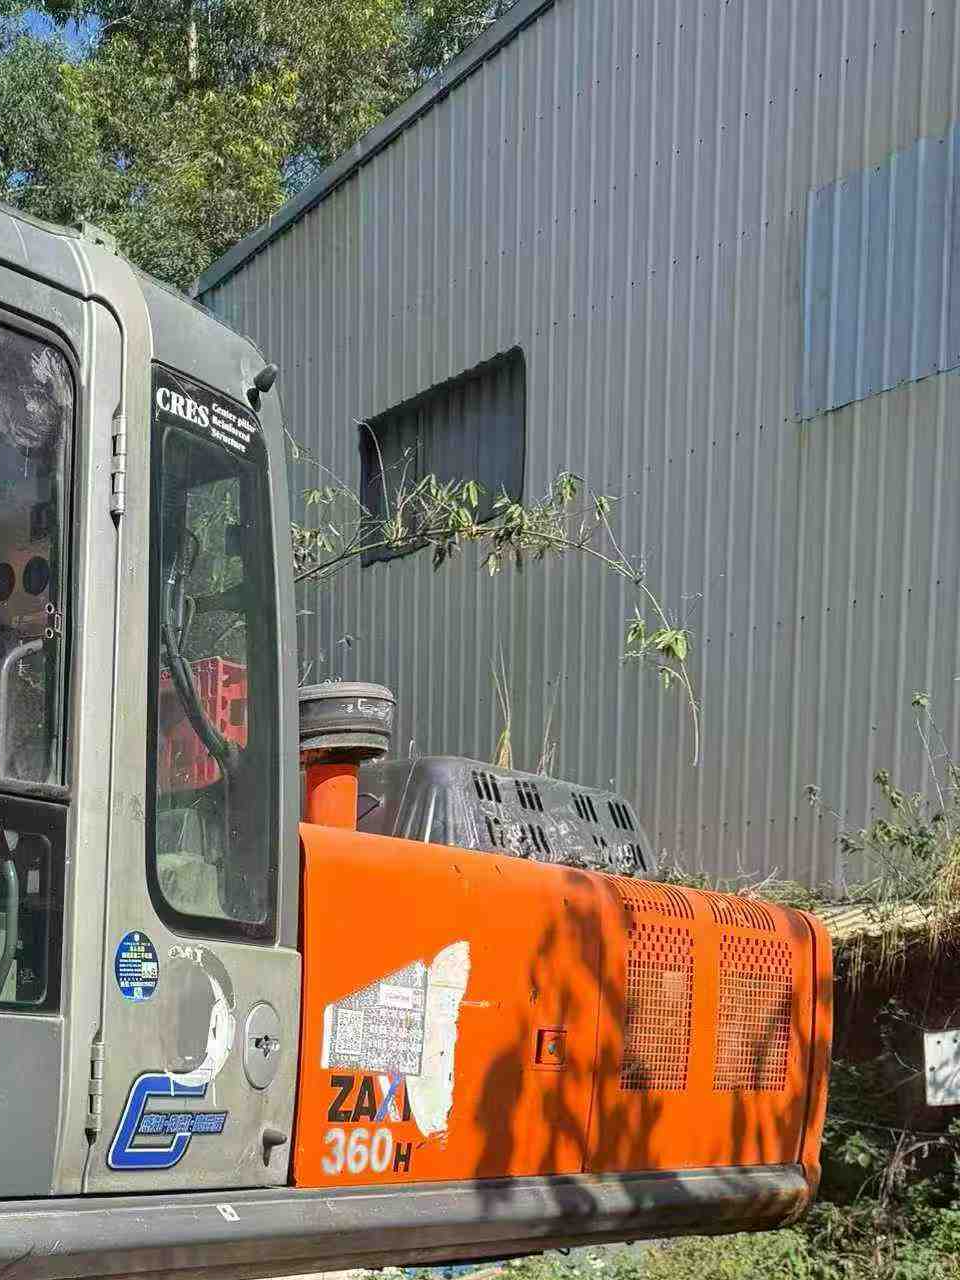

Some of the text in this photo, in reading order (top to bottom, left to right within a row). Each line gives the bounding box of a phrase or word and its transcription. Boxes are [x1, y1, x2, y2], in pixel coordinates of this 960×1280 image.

[156, 387, 210, 428] CRES
[212, 403, 237, 422] Center
[210, 427, 246, 453] Structure
[212, 414, 250, 443] Reinforced
